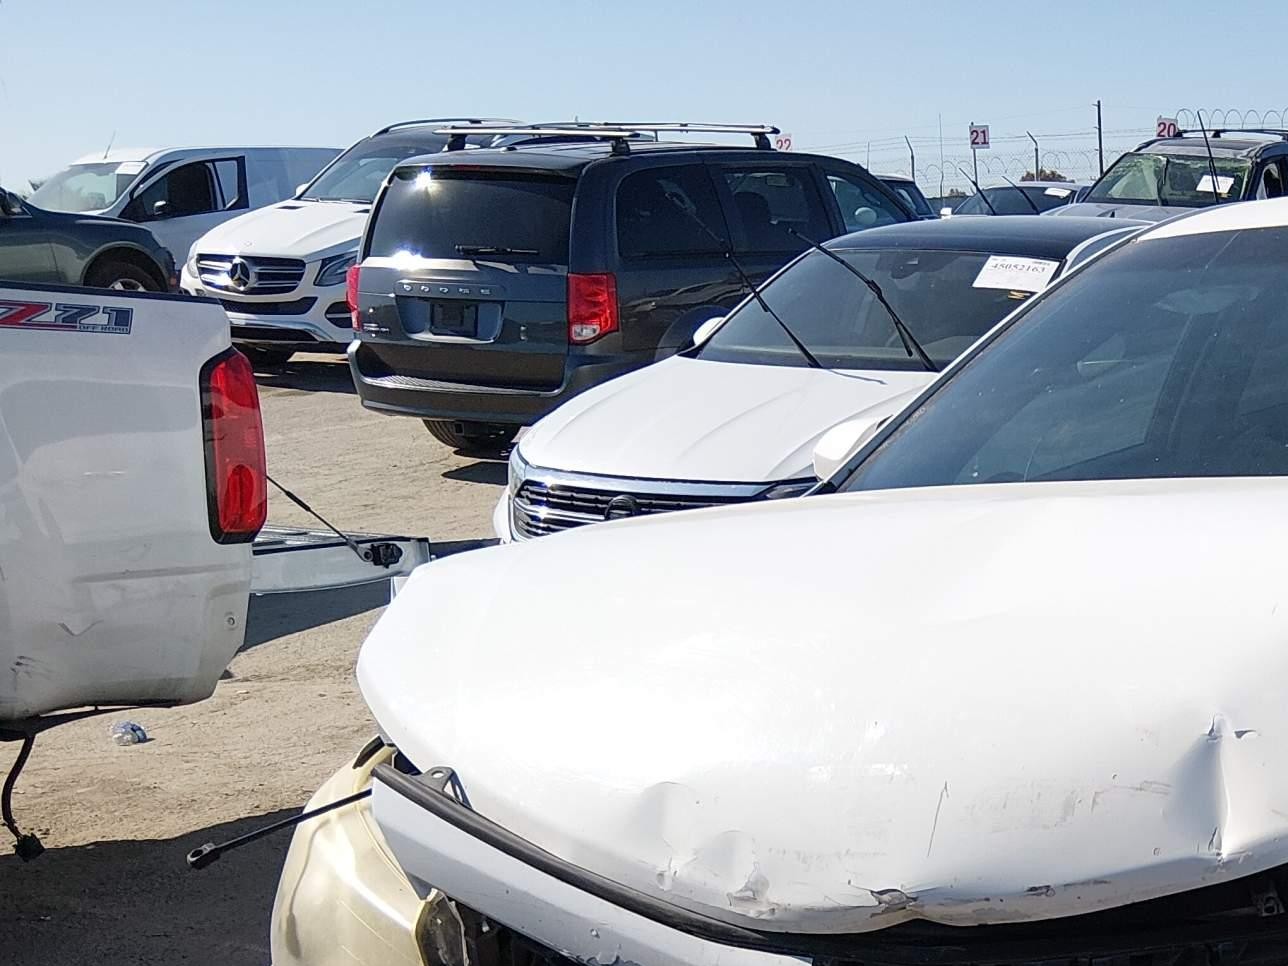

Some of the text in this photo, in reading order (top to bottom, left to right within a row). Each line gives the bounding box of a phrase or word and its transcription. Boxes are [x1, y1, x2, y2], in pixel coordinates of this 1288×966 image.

[971, 130, 989, 145] 21
[1157, 122, 1176, 138] 20
[776, 138, 791, 150] 22
